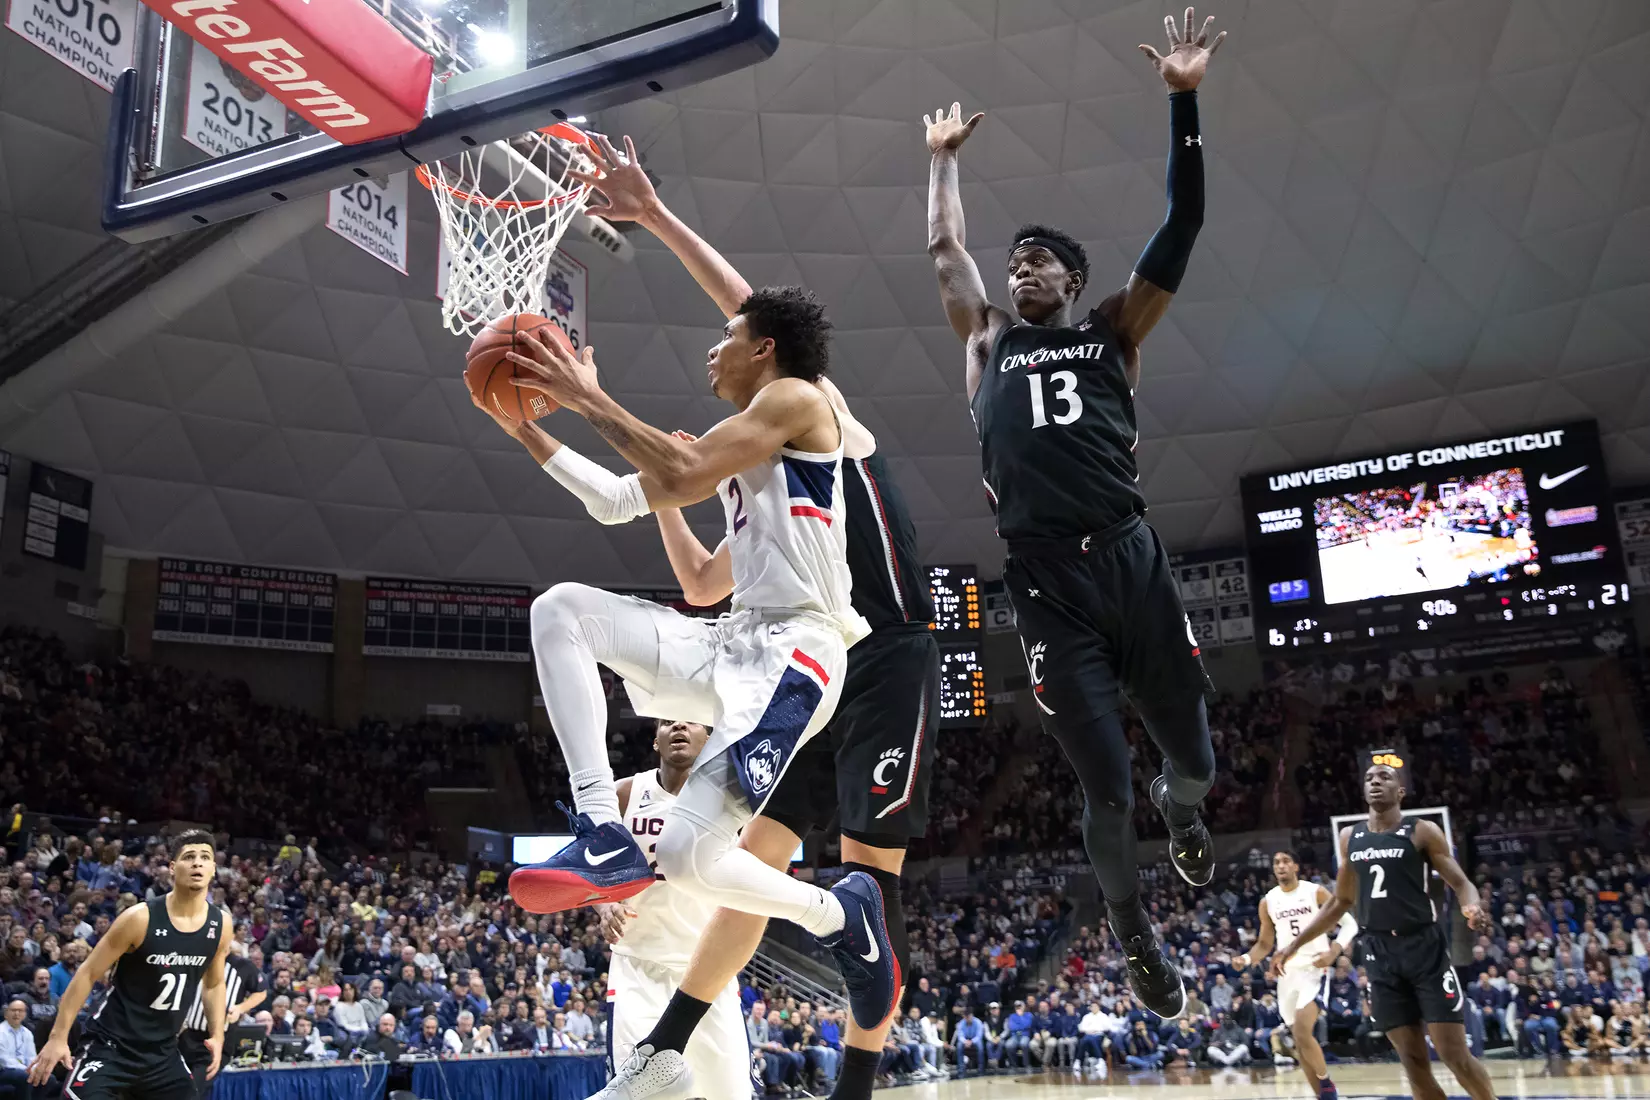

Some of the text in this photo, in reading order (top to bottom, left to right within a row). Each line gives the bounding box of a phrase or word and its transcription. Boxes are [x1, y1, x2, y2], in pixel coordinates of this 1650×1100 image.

[32, 4, 114, 67] NATIONAL
[43, 0, 122, 46] 010
[23, 20, 119, 86] CHAMPIONS
[223, 37, 370, 128] Farm
[202, 82, 273, 142] 2013
[197, 131, 231, 155] CHA
[204, 117, 250, 149] NATIO
[341, 183, 398, 230] 2014
[337, 219, 399, 263] CHAMPIONS
[343, 205, 395, 246] NATIONAL
[1001, 343, 1104, 373] CINCINNATI
[1026, 370, 1083, 429] 13
[1268, 430, 1564, 491] UNIVERSITY OF CONNECTICUT
[728, 477, 747, 536] 2
[1257, 508, 1302, 523] WELLS
[1260, 519, 1303, 533] FARGO
[195, 563, 232, 575] EAST
[240, 567, 333, 585] CONFERENCE
[1221, 577, 1244, 593] 42
[1268, 580, 1303, 595] CBS
[1601, 584, 1630, 605] 21
[1350, 848, 1405, 862] CINCINNATI
[1369, 864, 1387, 899] 2
[1275, 904, 1312, 920] UCONN
[1290, 919, 1299, 936] 5
[146, 952, 207, 967] CINCINNATI
[149, 972, 187, 1011] 21
